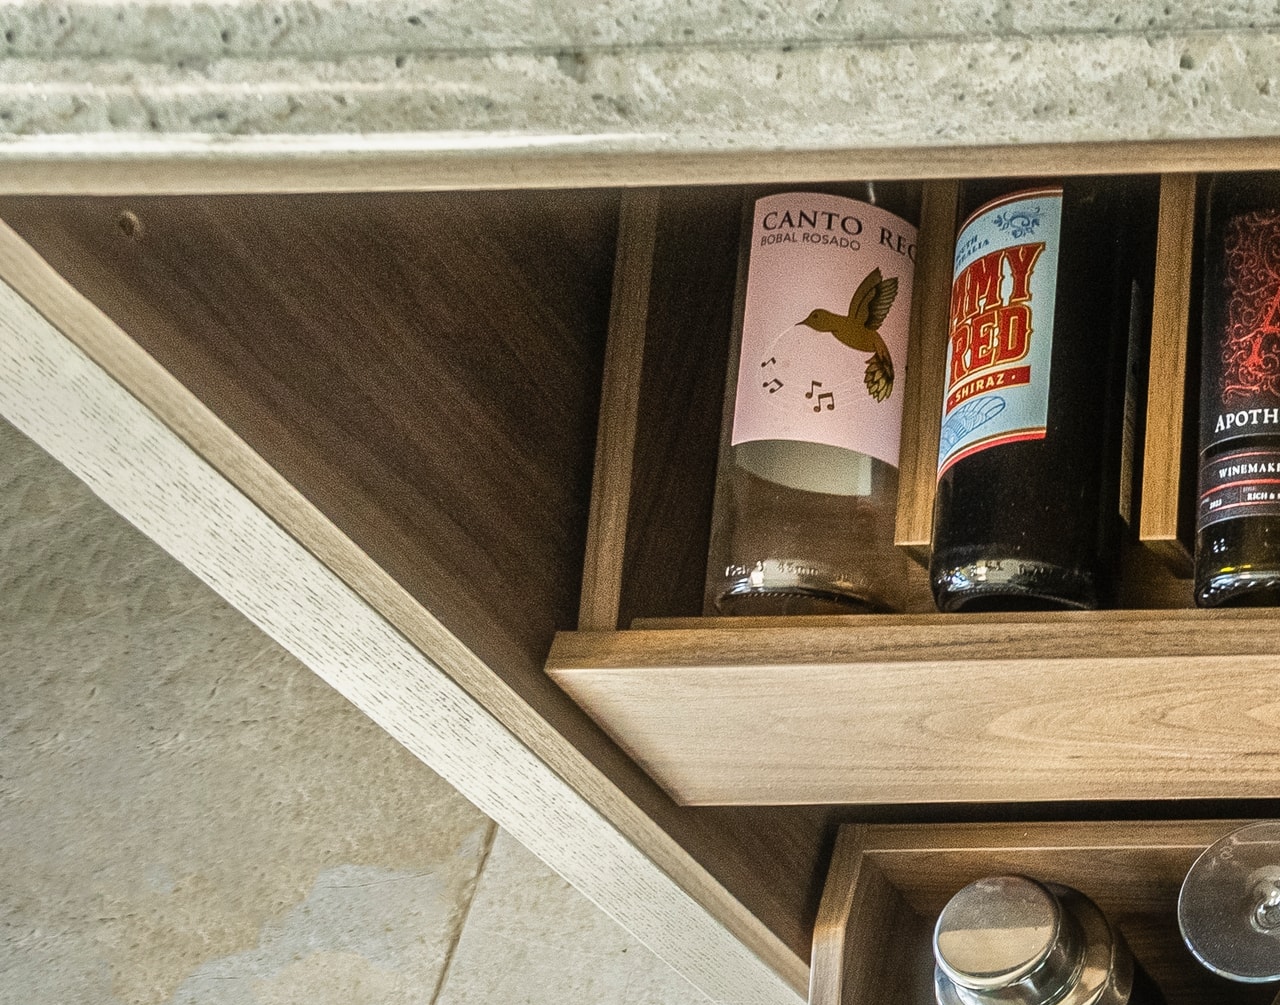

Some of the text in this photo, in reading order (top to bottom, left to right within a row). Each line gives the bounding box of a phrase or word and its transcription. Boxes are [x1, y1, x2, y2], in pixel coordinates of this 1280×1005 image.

[763, 210, 863, 236] CANTO
[761, 233, 861, 251] BOBAL ROSADO
[949, 303, 1034, 388] RED
[955, 373, 1005, 403] SHIRAZ
[1247, 492, 1268, 501] RICH
